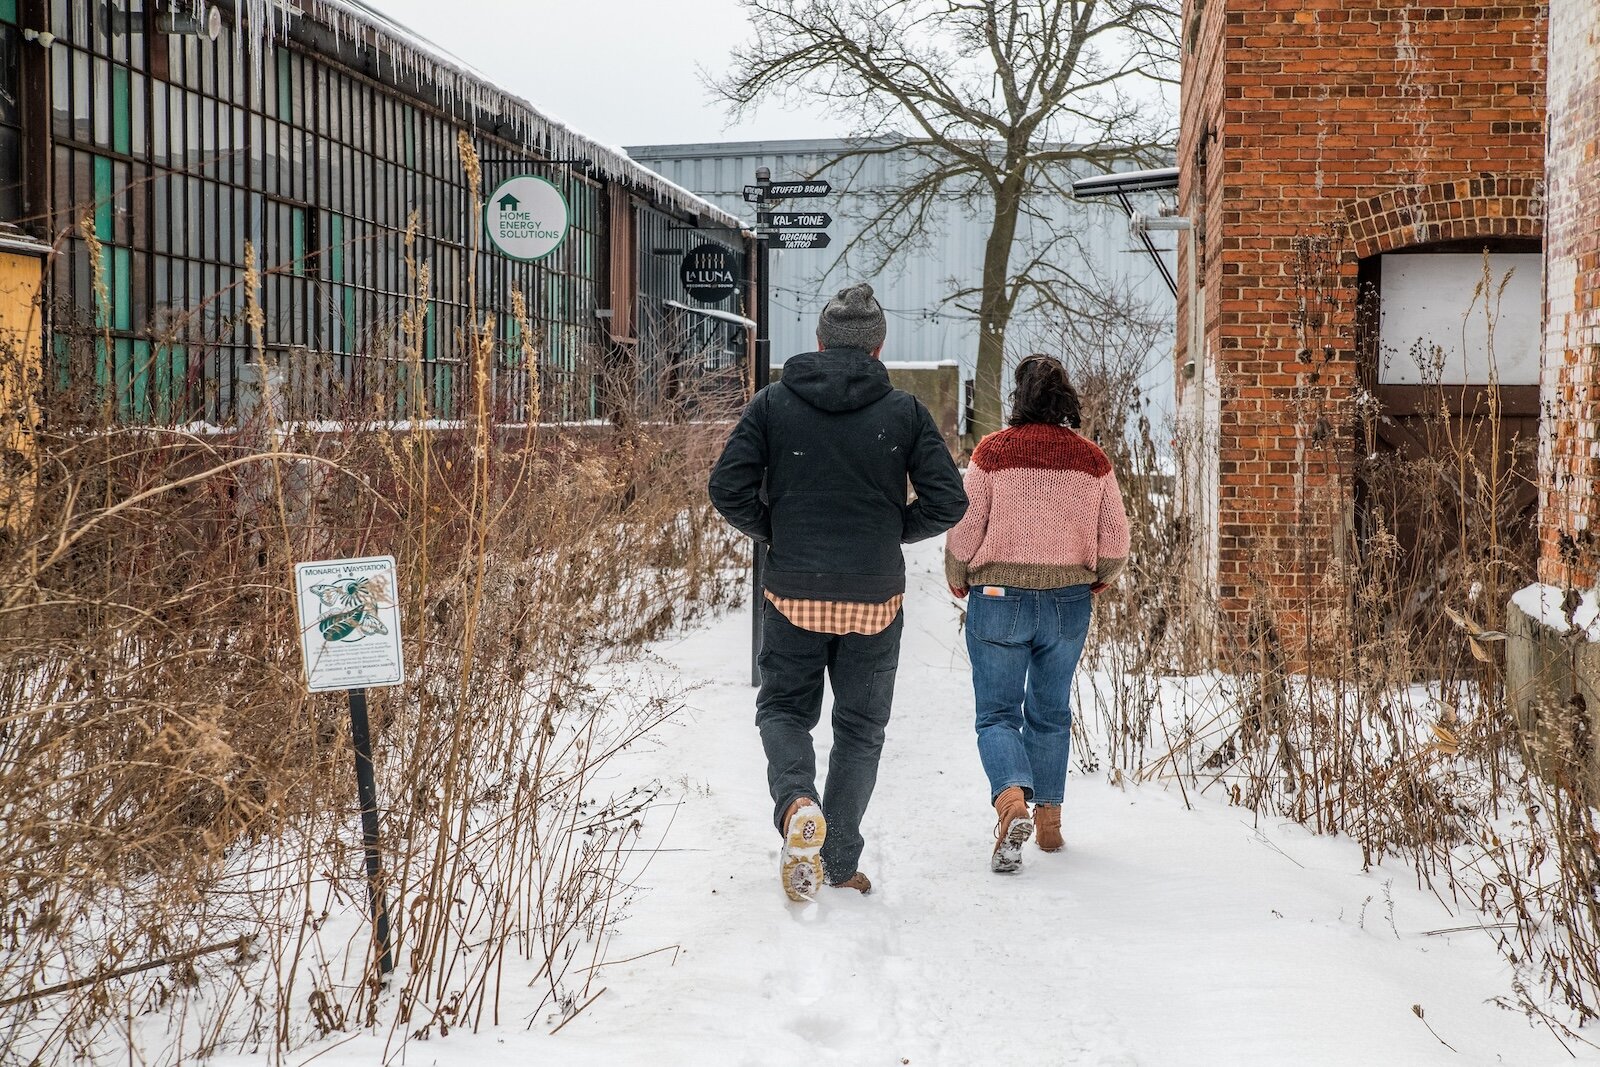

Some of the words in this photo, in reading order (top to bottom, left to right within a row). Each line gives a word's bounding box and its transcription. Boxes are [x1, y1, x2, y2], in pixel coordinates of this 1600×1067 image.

[771, 185, 804, 194] STUFFED
[804, 185, 828, 194] BRAIN
[499, 212, 531, 220] HOME
[499, 221, 542, 229] ENERGY
[499, 230, 559, 239] SOLUTIONS
[779, 233, 818, 241] ORIGINAL
[785, 240, 812, 249] TATTOO
[699, 270, 734, 282] LUNA
